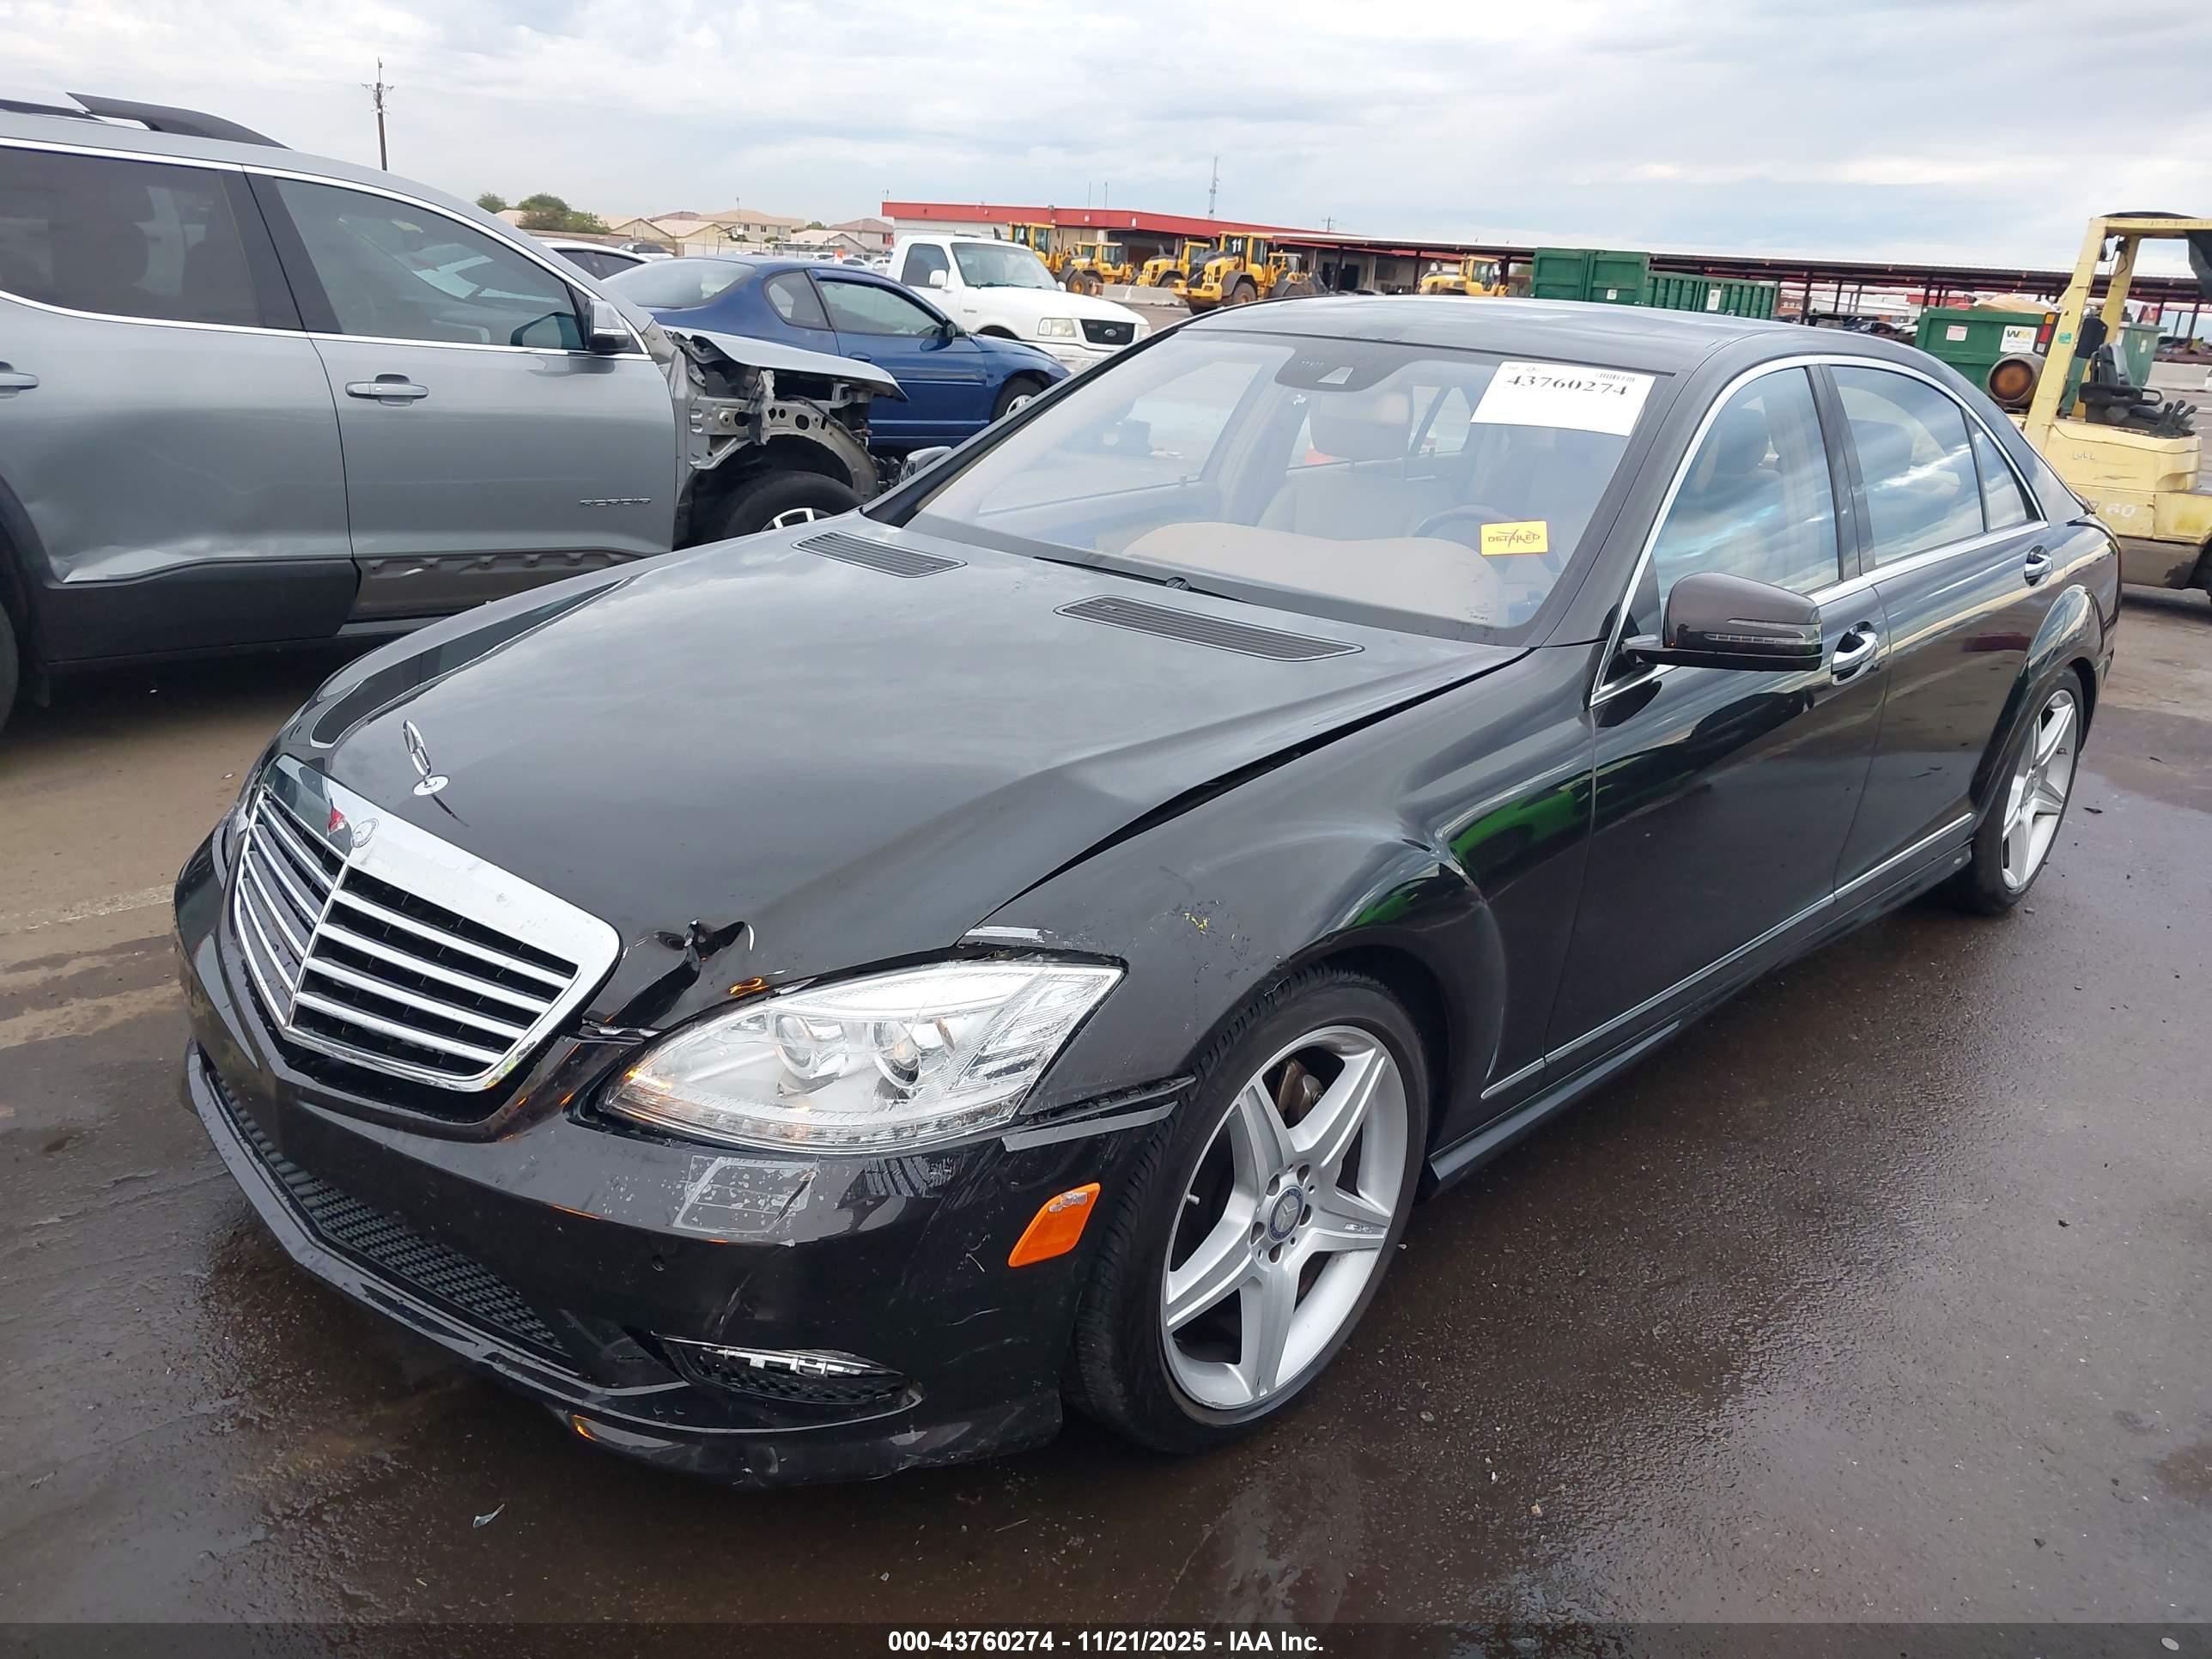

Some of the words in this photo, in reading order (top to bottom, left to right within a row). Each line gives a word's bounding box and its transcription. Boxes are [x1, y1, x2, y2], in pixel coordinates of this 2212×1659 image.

[1231, 239, 1243, 253] 11
[1505, 375, 1627, 396] 43760274
[1487, 529, 1540, 547] DETAILED
